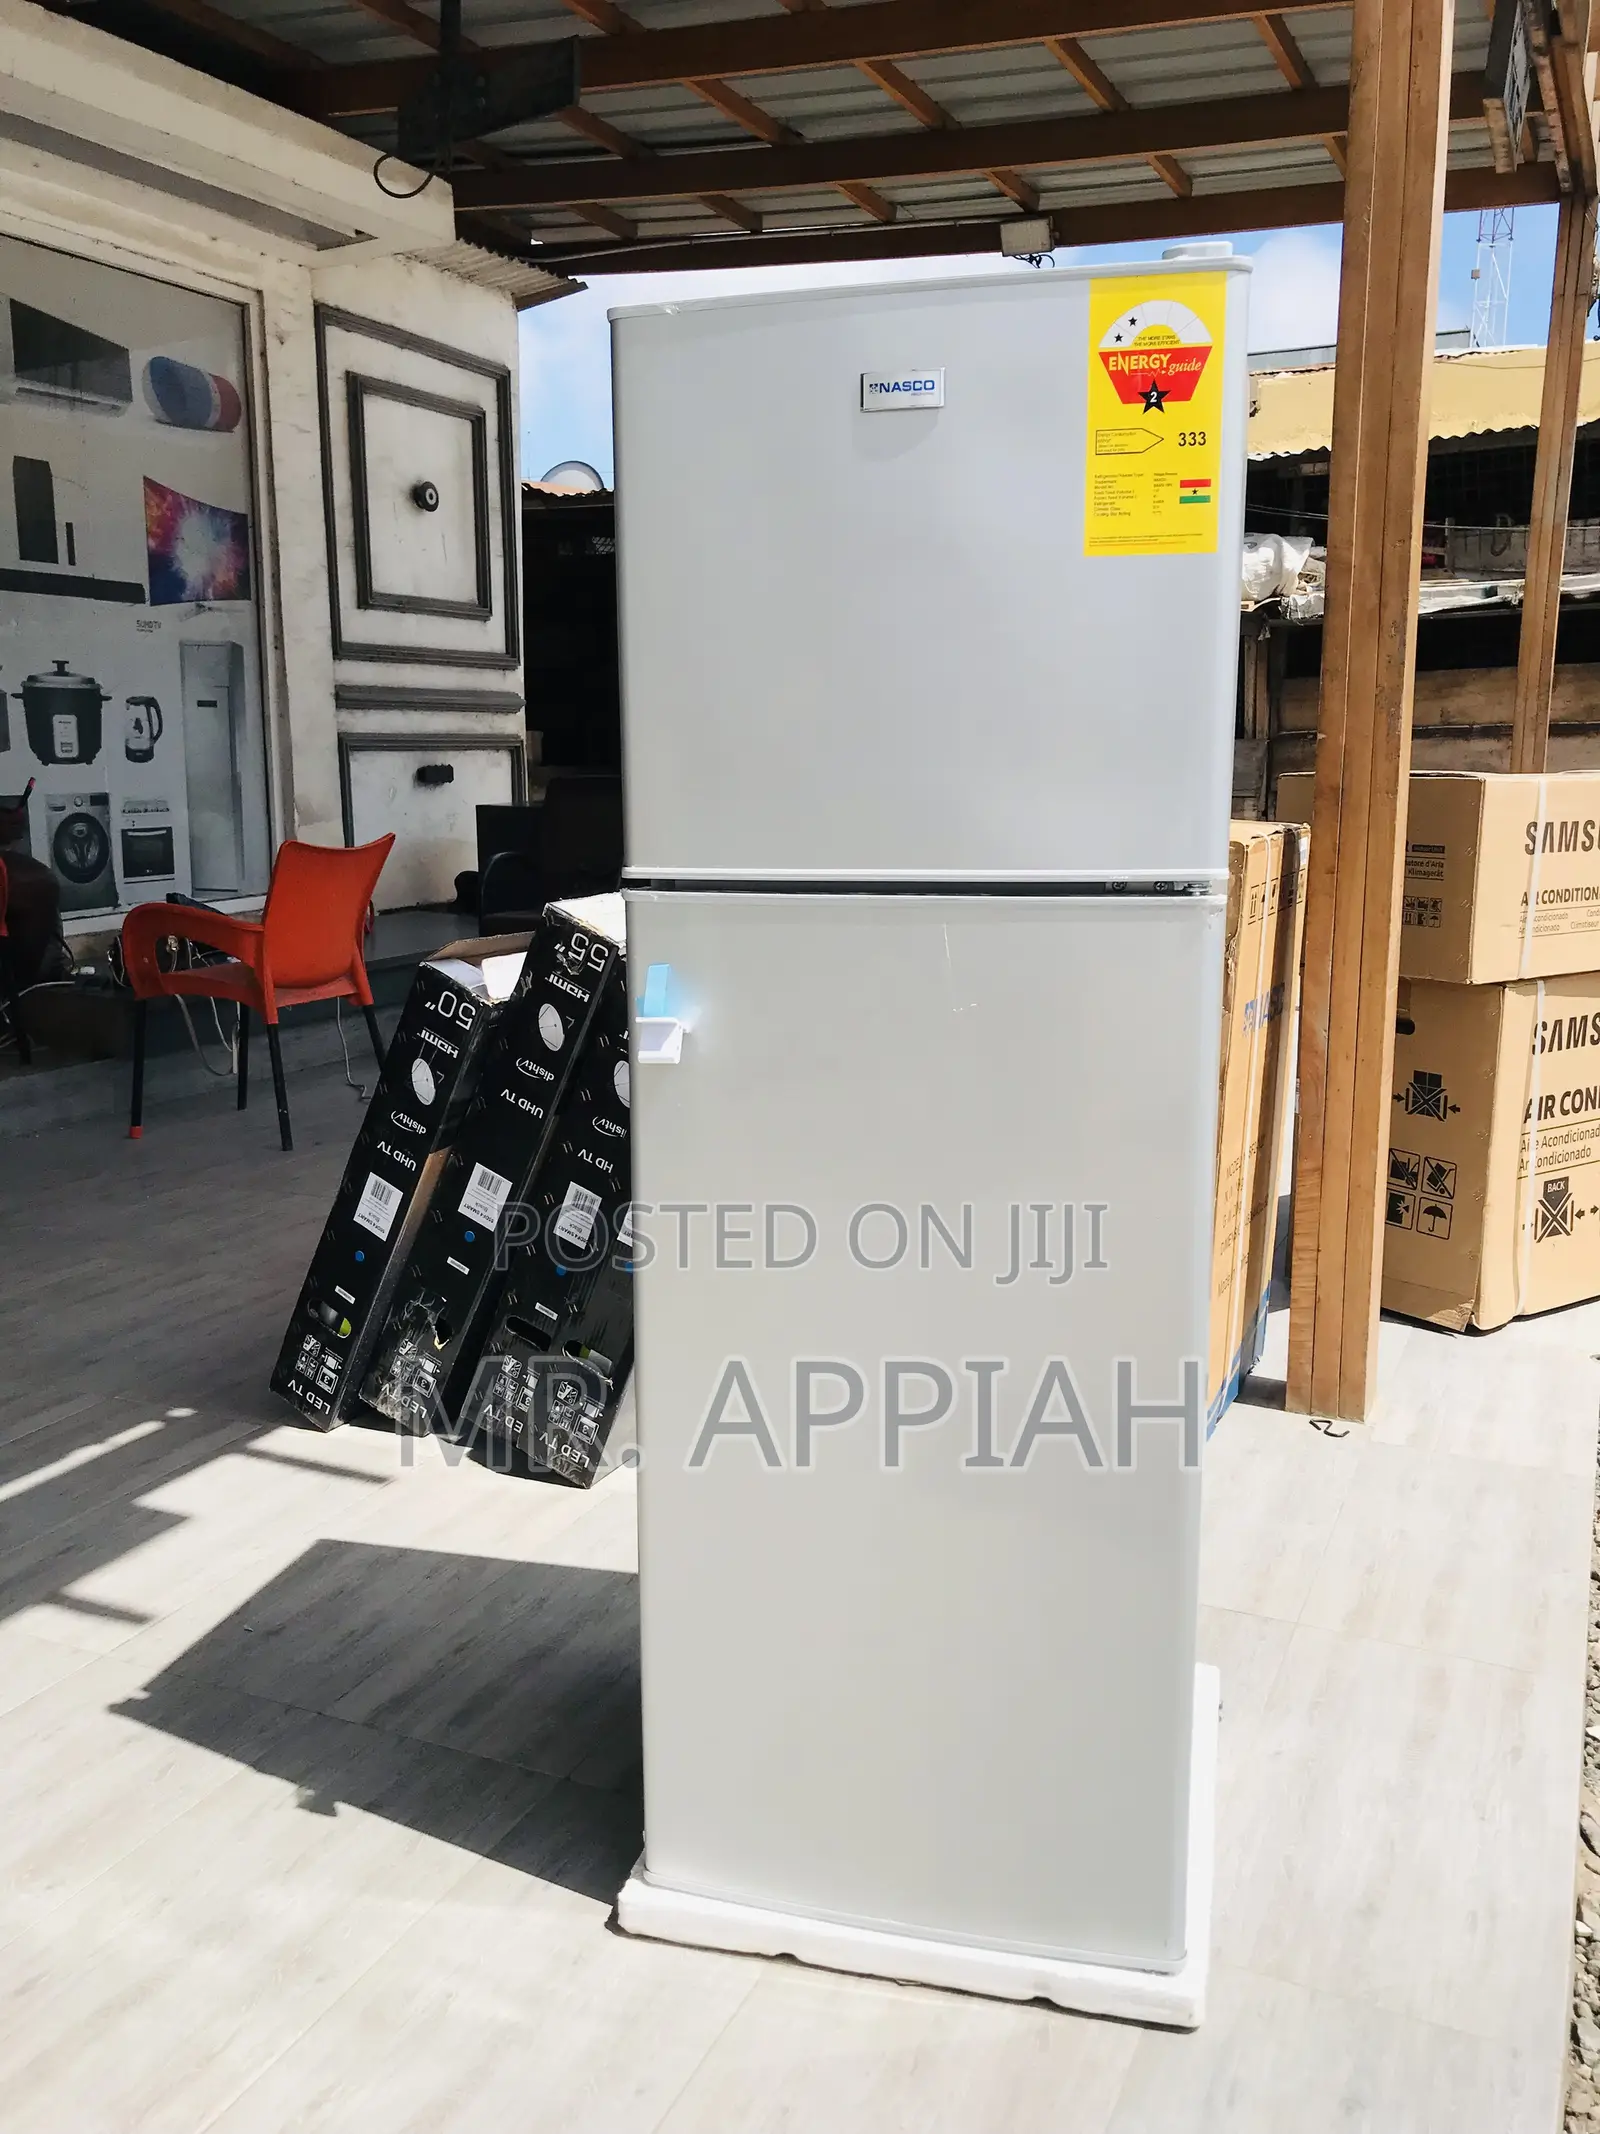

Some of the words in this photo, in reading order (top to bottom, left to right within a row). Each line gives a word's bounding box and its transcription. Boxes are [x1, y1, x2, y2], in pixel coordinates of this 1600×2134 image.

[1108, 352, 1171, 376] ENERGY
[1168, 358, 1202, 376] guide
[879, 380, 935, 394] NASCO
[1149, 391, 1158, 403] 2
[1178, 431, 1207, 447] 333
[1524, 819, 1600, 856] SAMS
[1541, 886, 1600, 905] CONDITION
[544, 974, 590, 1003] HDMI
[416, 1029, 459, 1059] HDMI
[515, 1057, 555, 1081] dishtv
[500, 1088, 516, 1104] TV
[1559, 1084, 1600, 1117] CON
[518, 1098, 544, 1119] UHD
[390, 1110, 427, 1134] dishtv
[376, 1140, 392, 1155] TV
[577, 1148, 593, 1164] TV
[1535, 1144, 1592, 1169] ondicionado
[393, 1150, 417, 1172] UHD
[1547, 1180, 1566, 1193] BACK
[287, 1379, 303, 1397] TV
[305, 1391, 331, 1415] LED
[504, 1415, 524, 1434] ED
[539, 1431, 557, 1451] TV
[560, 1443, 590, 1469] LED
